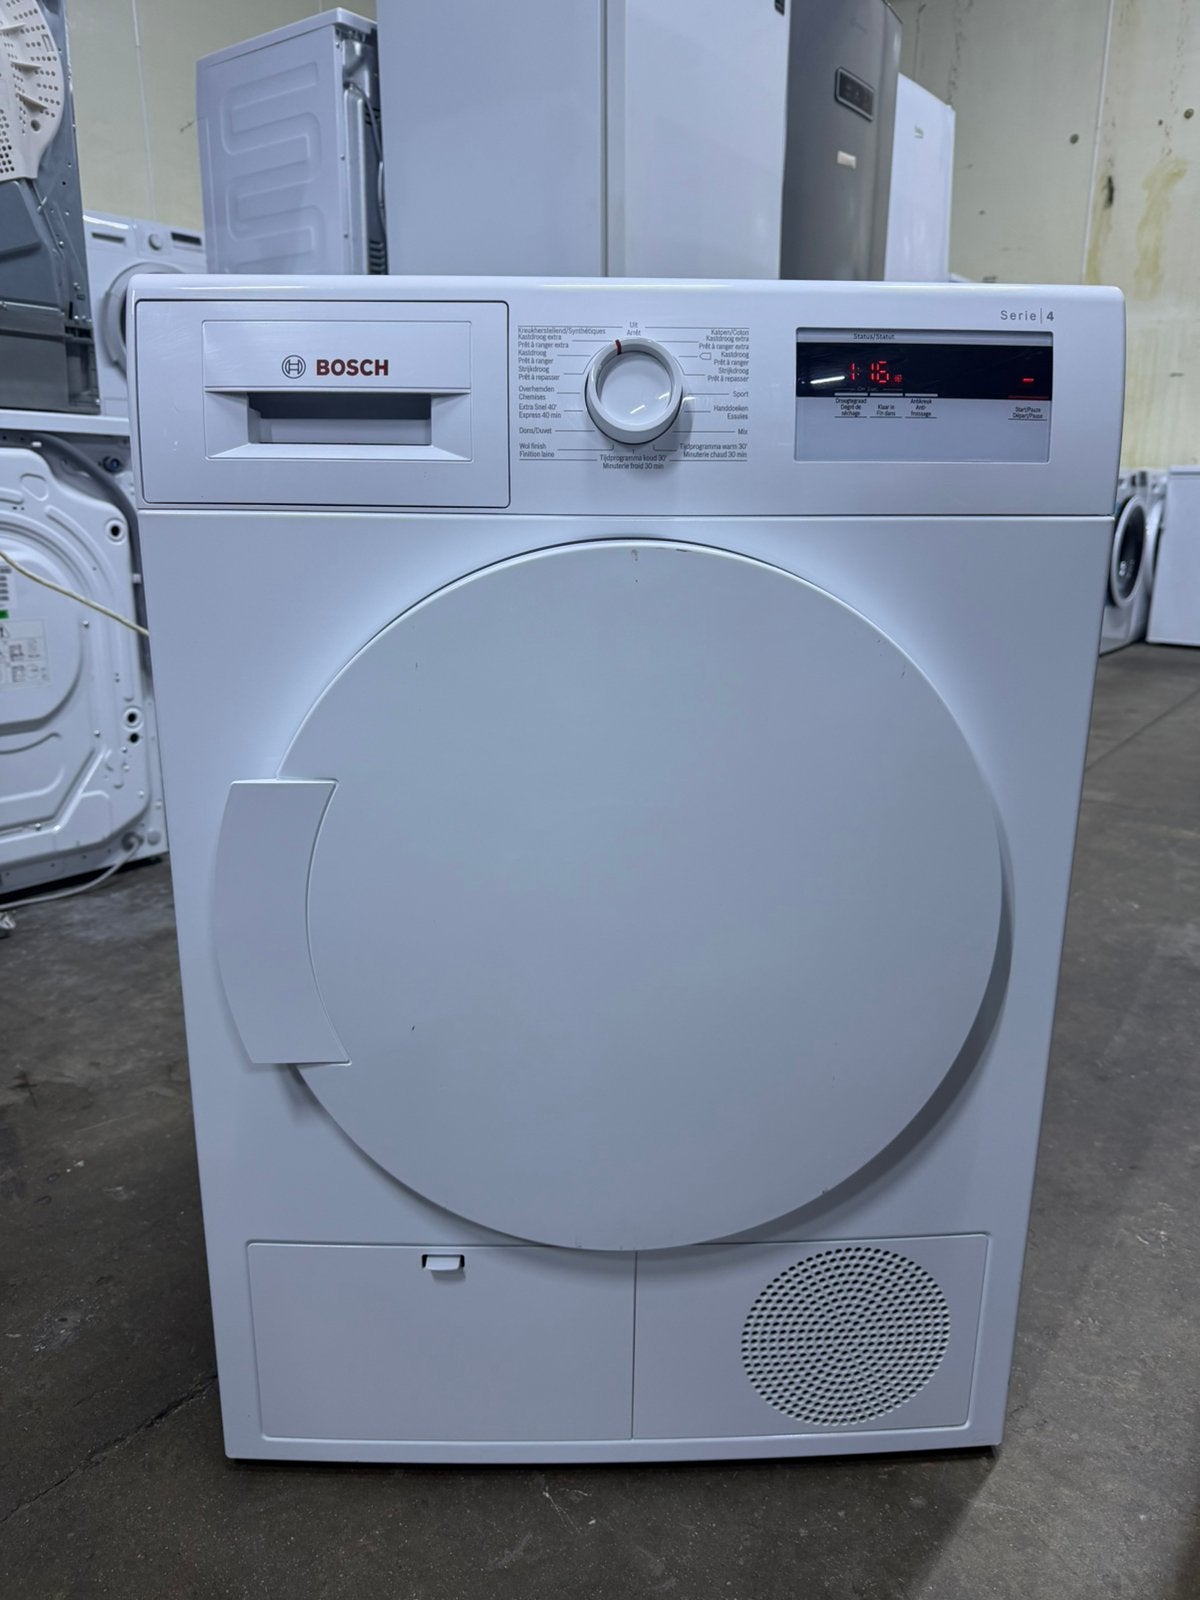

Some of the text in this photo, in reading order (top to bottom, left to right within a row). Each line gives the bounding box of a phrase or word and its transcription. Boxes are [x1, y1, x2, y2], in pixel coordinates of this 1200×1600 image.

[1000, 310, 1055, 321] Serie 4
[518, 333, 546, 341] Kastdroog
[716, 343, 734, 351] ranger
[518, 349, 547, 357] Kastdroog
[721, 351, 750, 359] Kastdroog
[316, 359, 389, 376] BOSCH
[718, 367, 750, 375] Strijkdroog
